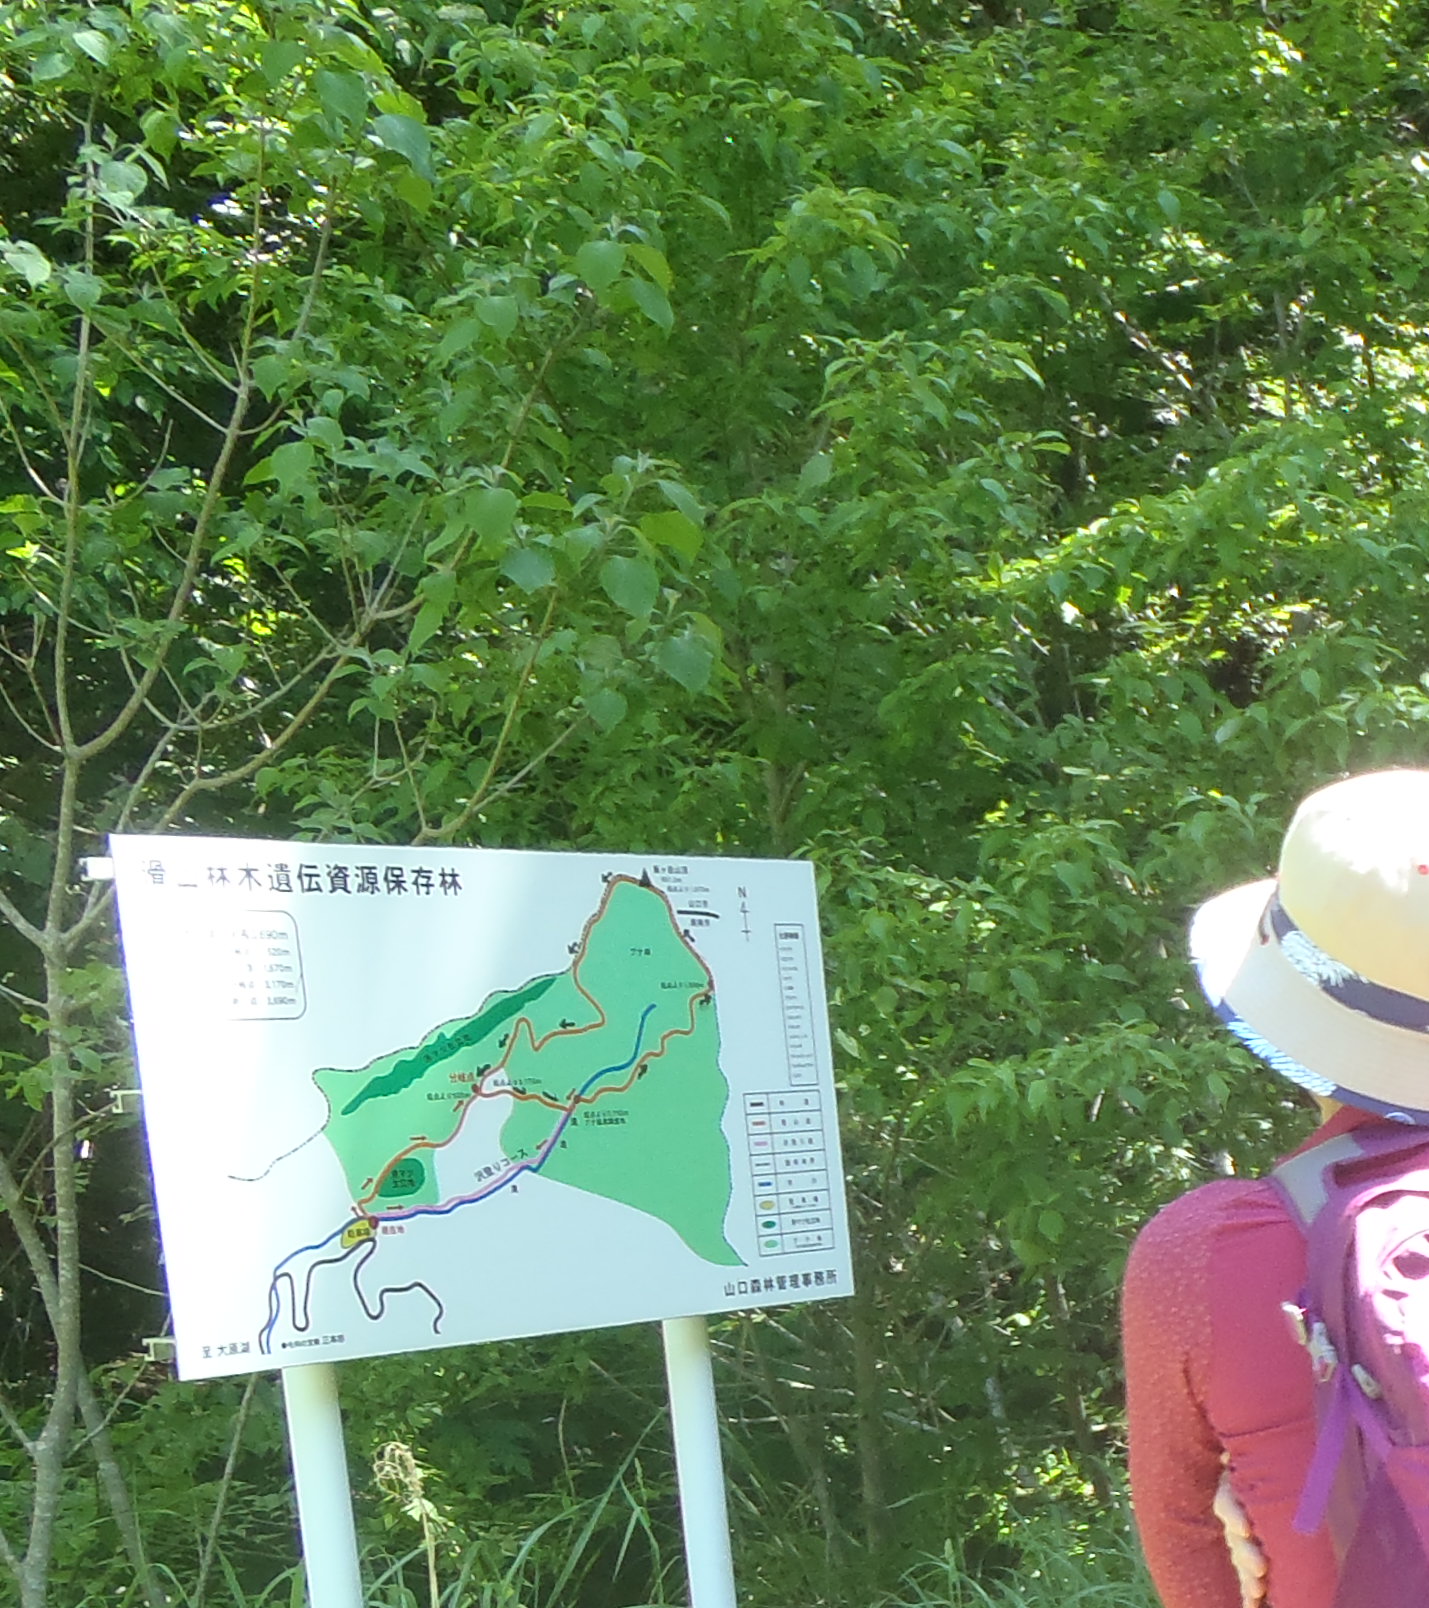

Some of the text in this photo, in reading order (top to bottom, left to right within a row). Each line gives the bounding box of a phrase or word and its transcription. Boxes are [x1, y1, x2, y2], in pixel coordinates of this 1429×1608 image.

[143, 860, 462, 896] 滑林木遺伝資源保存林
[738, 887, 747, 898] N
[724, 1269, 838, 1296] 山口森林管理事務所
